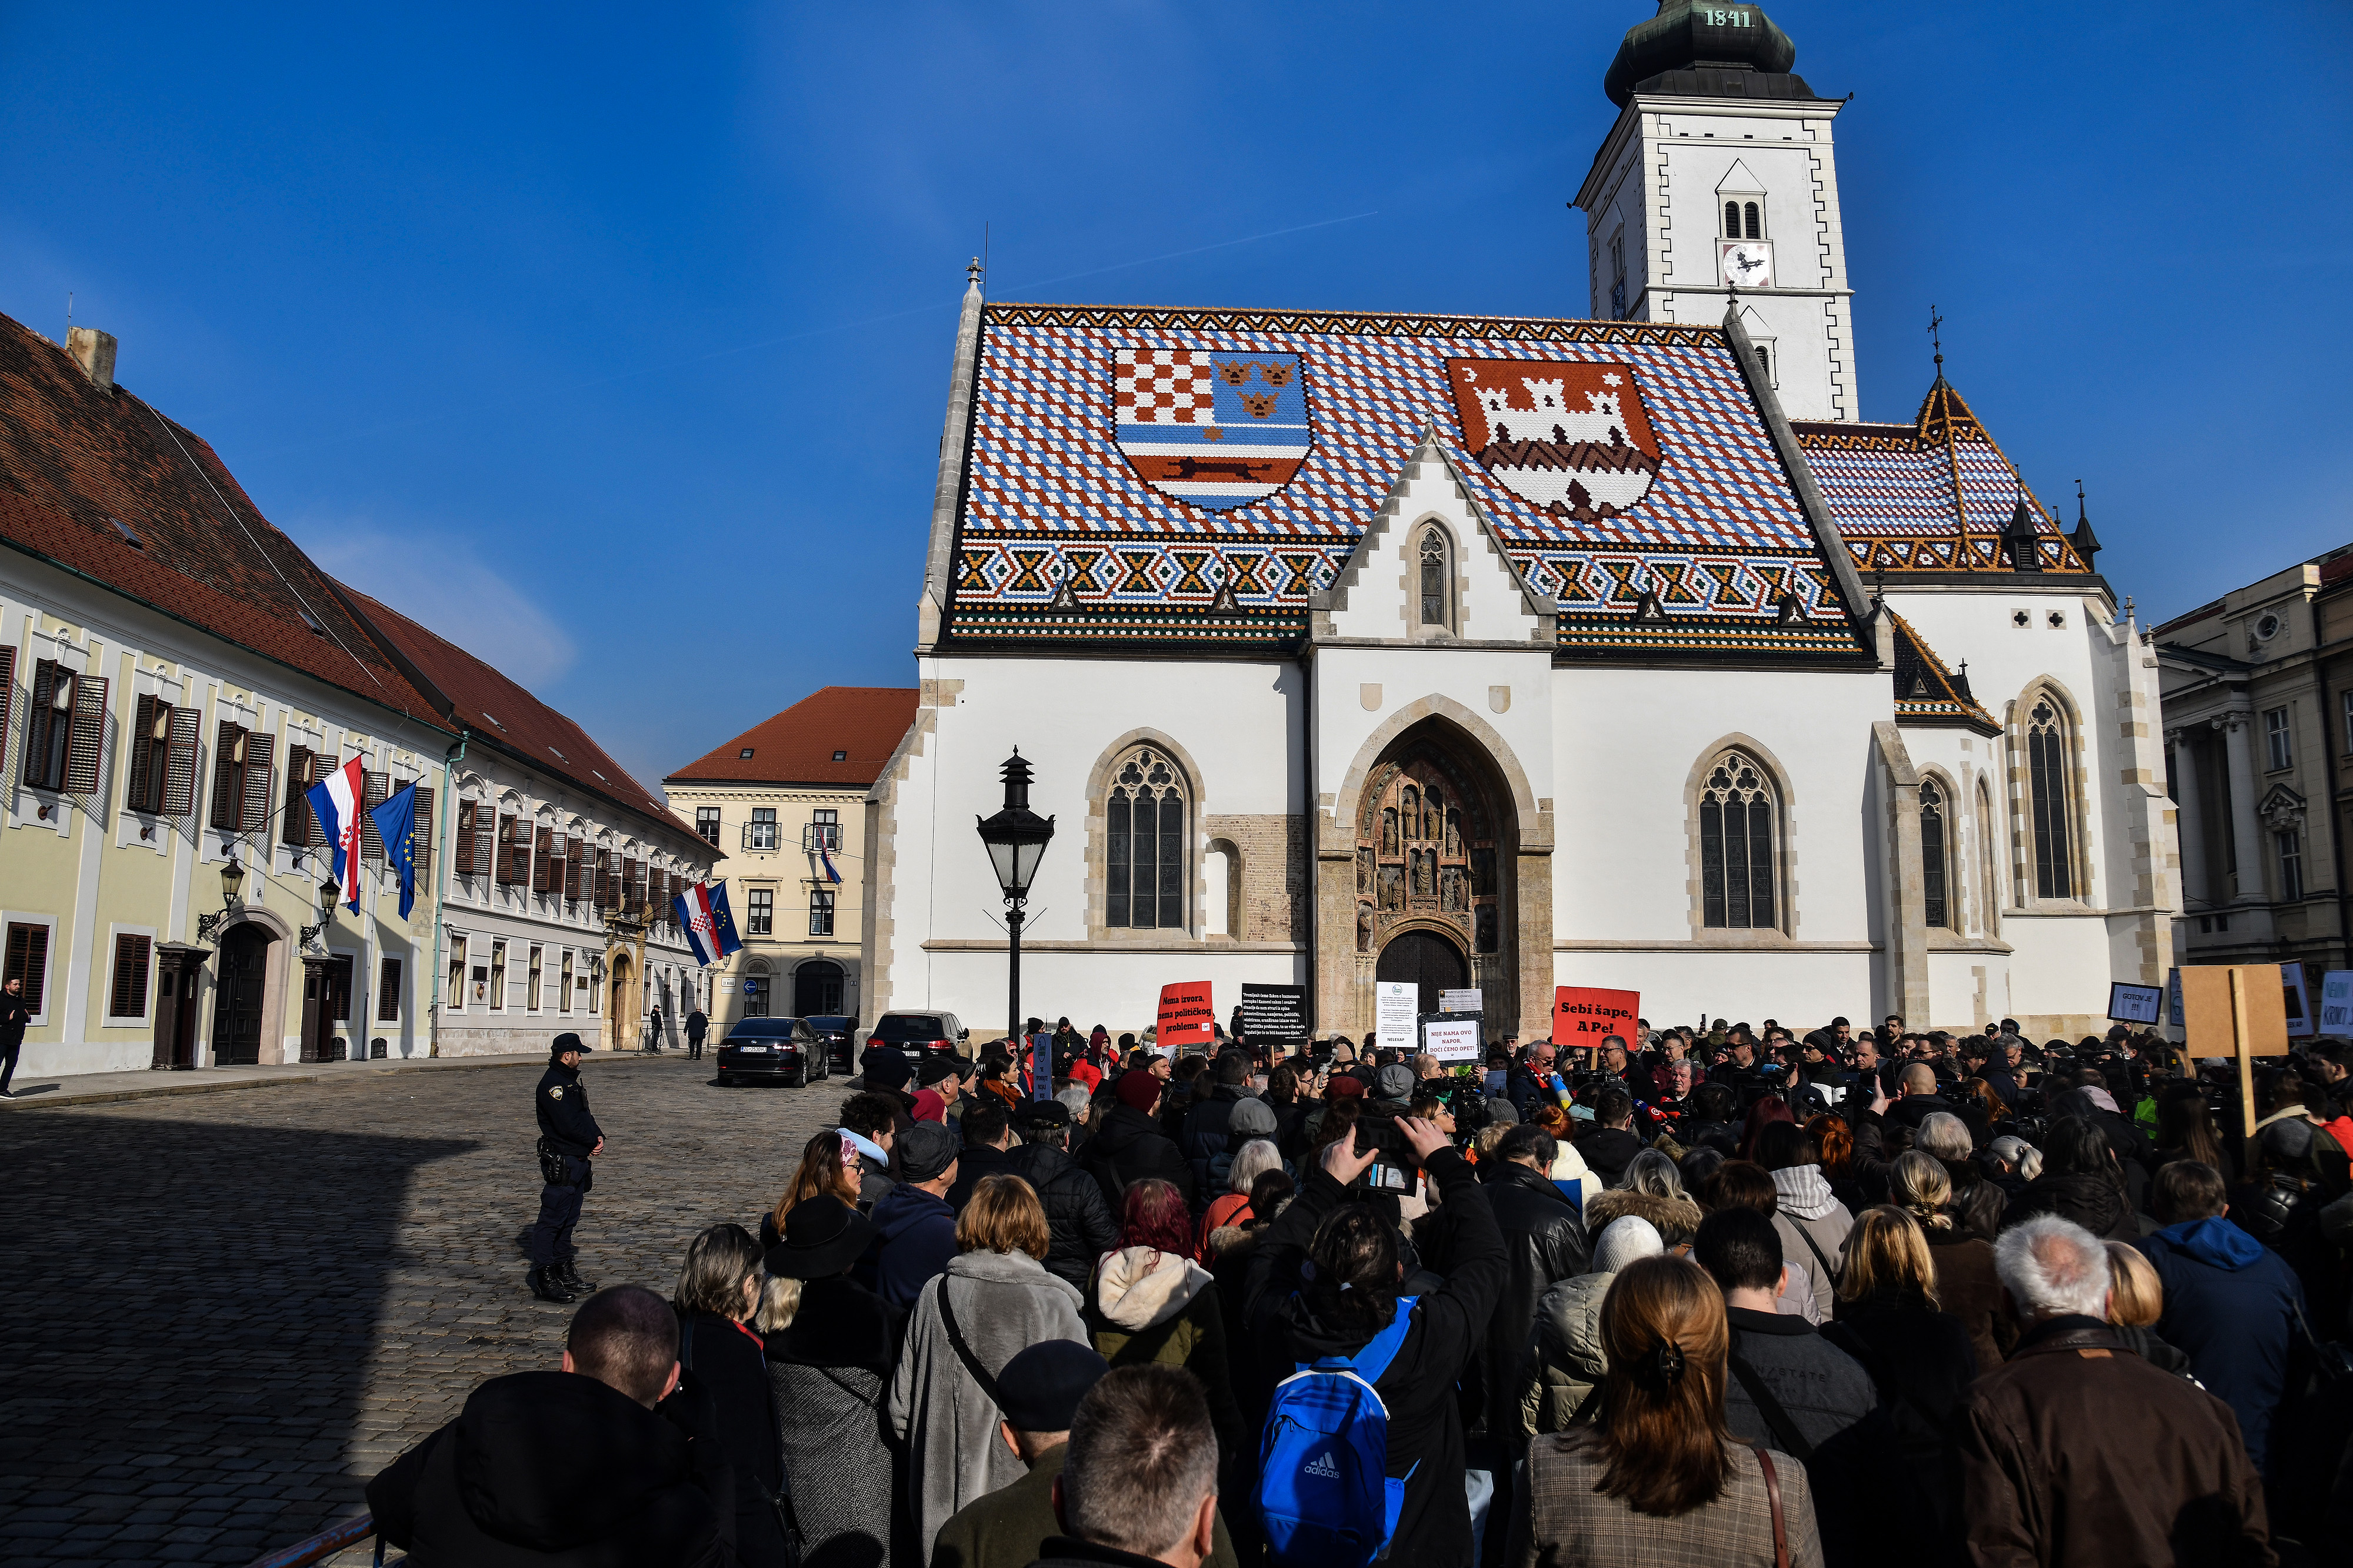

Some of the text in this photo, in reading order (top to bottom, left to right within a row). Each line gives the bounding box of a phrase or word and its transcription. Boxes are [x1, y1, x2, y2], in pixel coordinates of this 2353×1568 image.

[1705, 9, 1755, 28] 1841.
[1163, 997, 1179, 1005] Nema
[1158, 1007, 1211, 1020] nema političkog
[1561, 1002, 1632, 1020] Sebi šape,
[1166, 1022, 1198, 1034] problema
[1577, 1021, 1614, 1034] A Pe!
[1304, 1464, 1340, 1479] adidas
